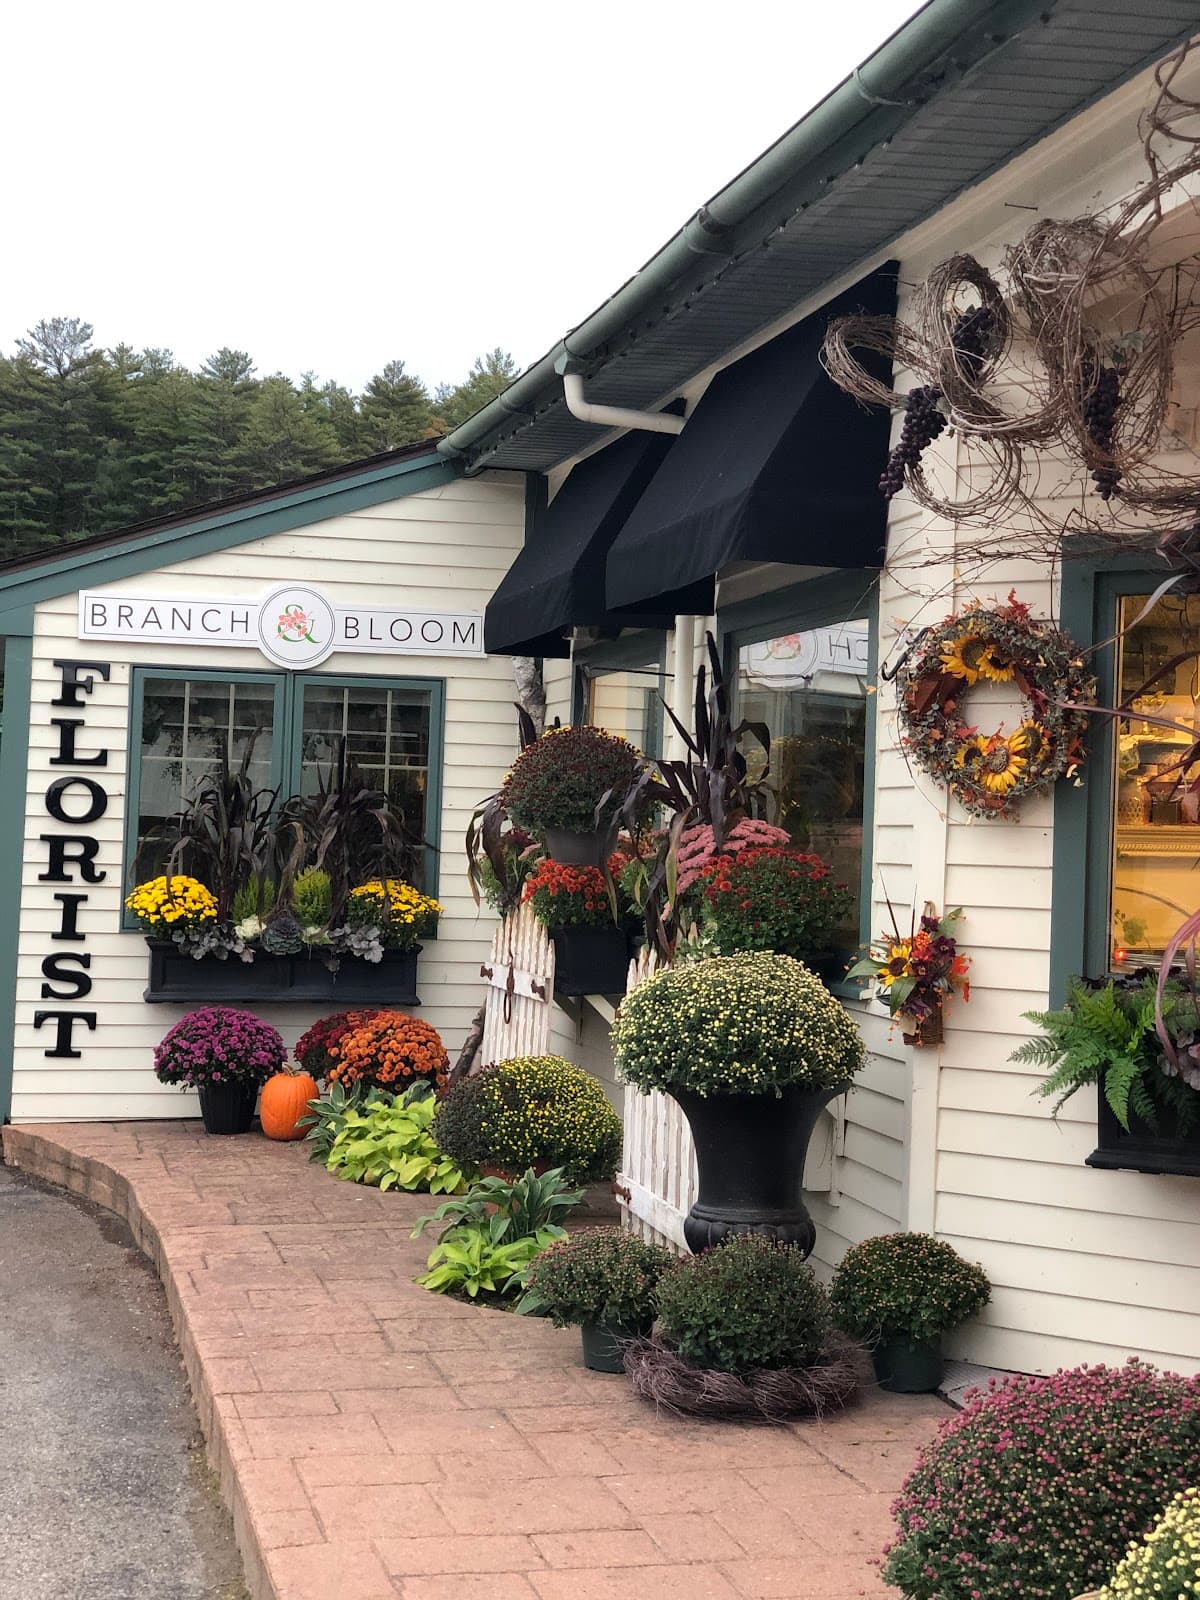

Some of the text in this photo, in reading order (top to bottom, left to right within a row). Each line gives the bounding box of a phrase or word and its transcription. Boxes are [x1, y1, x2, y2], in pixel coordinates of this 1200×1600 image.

[90, 603, 477, 645] BRANCH & BLOOM
[33, 659, 111, 1058] FLORIST
